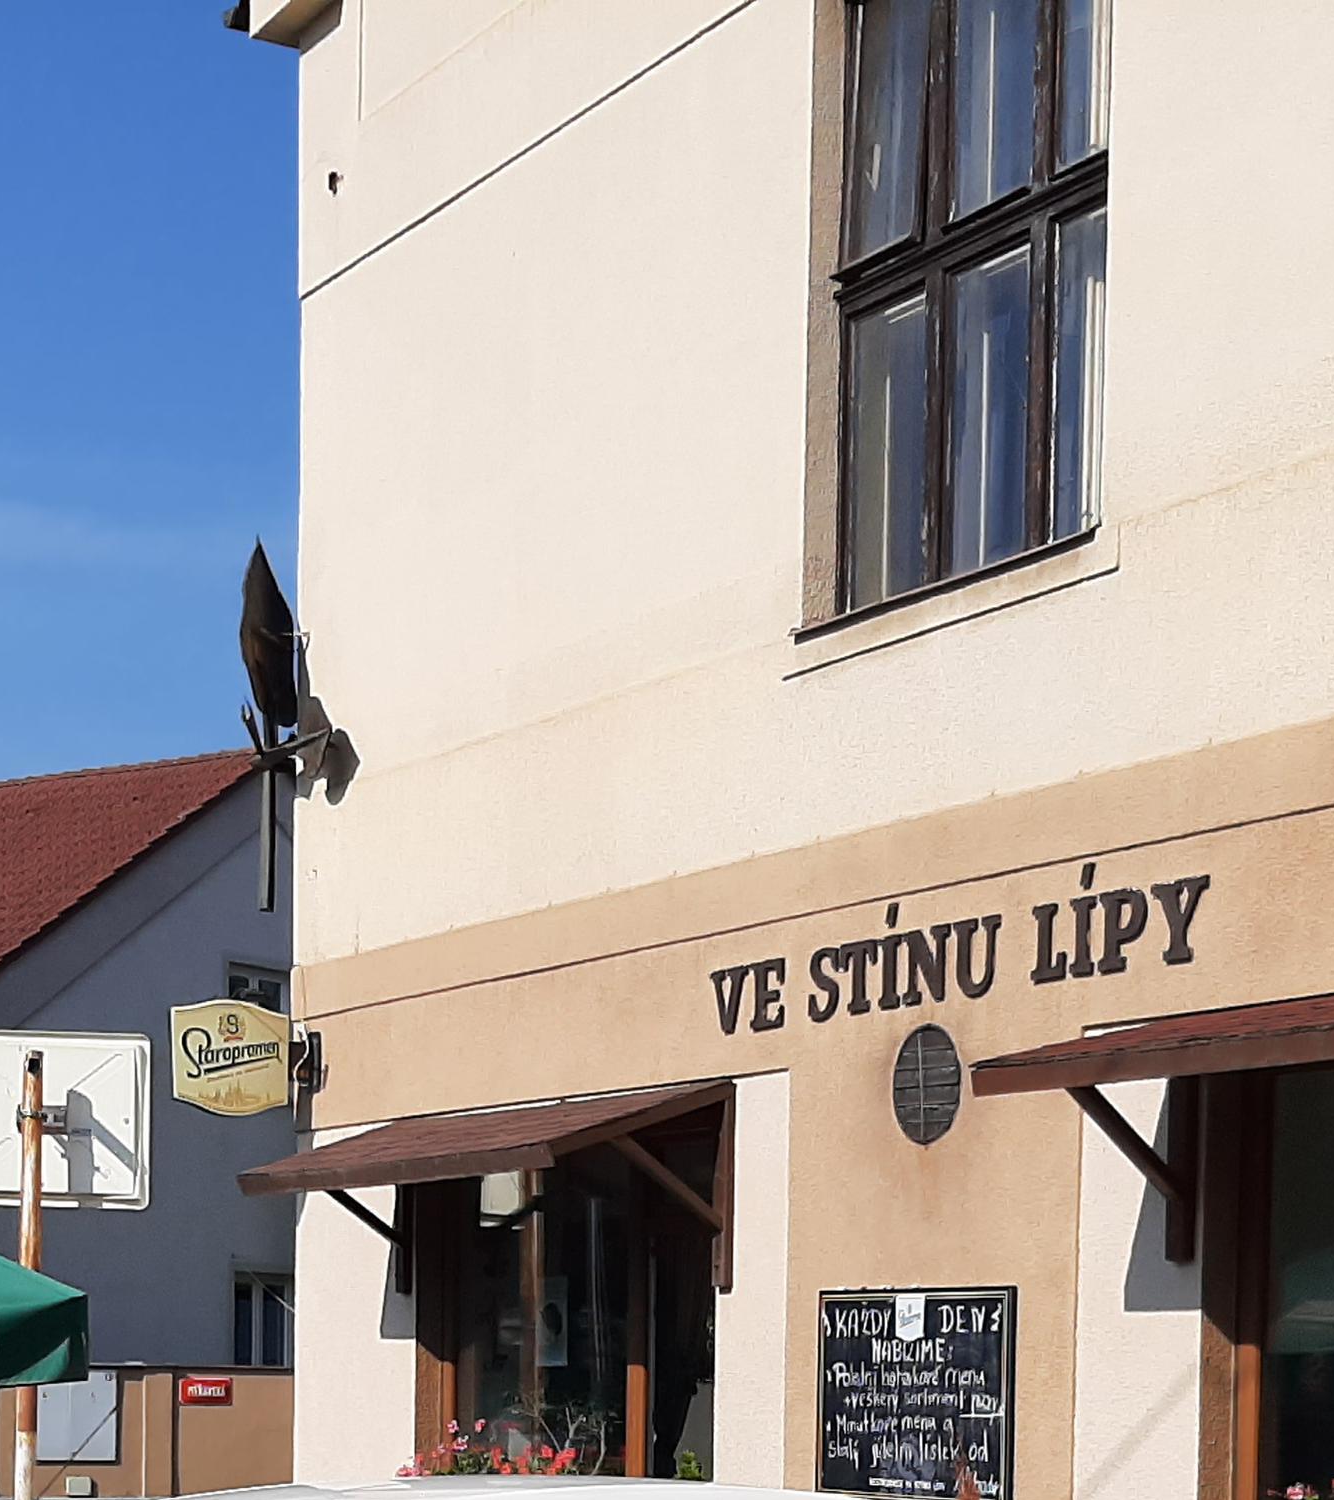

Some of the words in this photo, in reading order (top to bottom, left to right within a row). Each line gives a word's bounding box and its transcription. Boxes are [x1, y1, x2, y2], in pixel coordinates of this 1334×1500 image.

[710, 958, 786, 1035] VE
[808, 902, 1002, 1023] STÍNU
[1030, 862, 1211, 986] LÍPY
[181, 1027, 283, 1079] Staropramen
[937, 1305, 985, 1333] DEN
[968, 1429, 988, 1462] od
